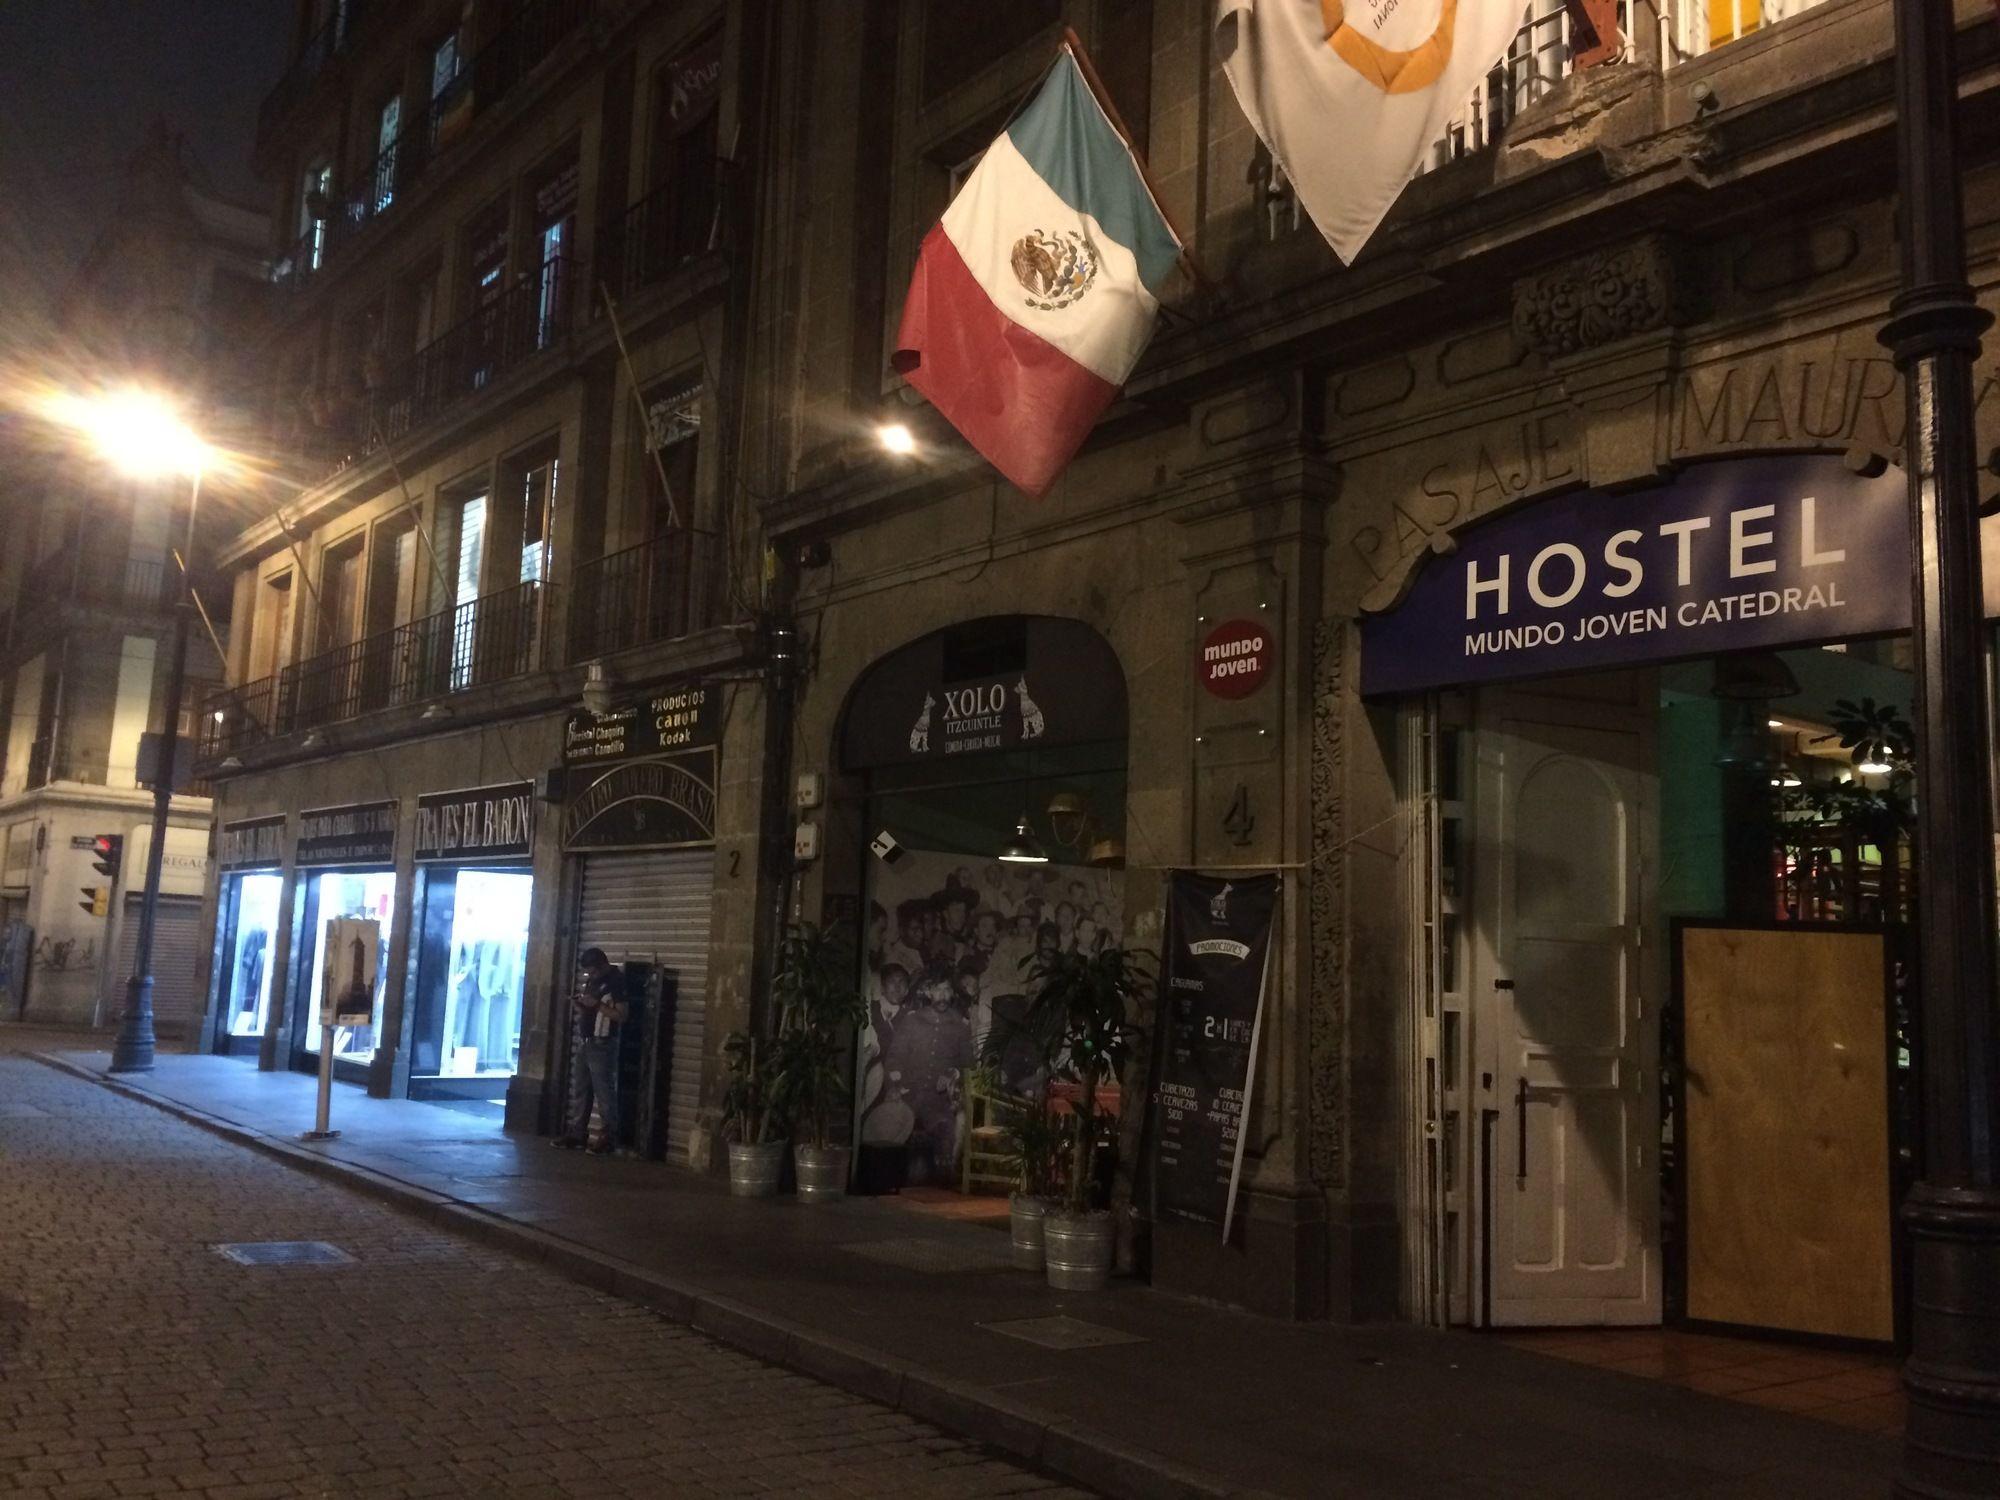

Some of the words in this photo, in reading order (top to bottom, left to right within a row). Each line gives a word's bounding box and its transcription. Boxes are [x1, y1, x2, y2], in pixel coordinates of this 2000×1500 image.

[1350, 408, 1574, 582] PASAJE
[1466, 497, 1846, 620] HOSTEL
[1465, 621, 1565, 656] MUNDO
[1572, 606, 1667, 642] JOVEN
[1677, 582, 1846, 627] CATEDRAL
[943, 684, 1005, 720] XOLO
[946, 715, 1002, 735] ITZCUINTLE
[659, 729, 691, 746] Kodak
[415, 804, 460, 857] TRAJES
[462, 802, 478, 848] EL
[482, 795, 530, 847] BARON
[1224, 784, 1255, 847] 4
[728, 850, 743, 879] 2
